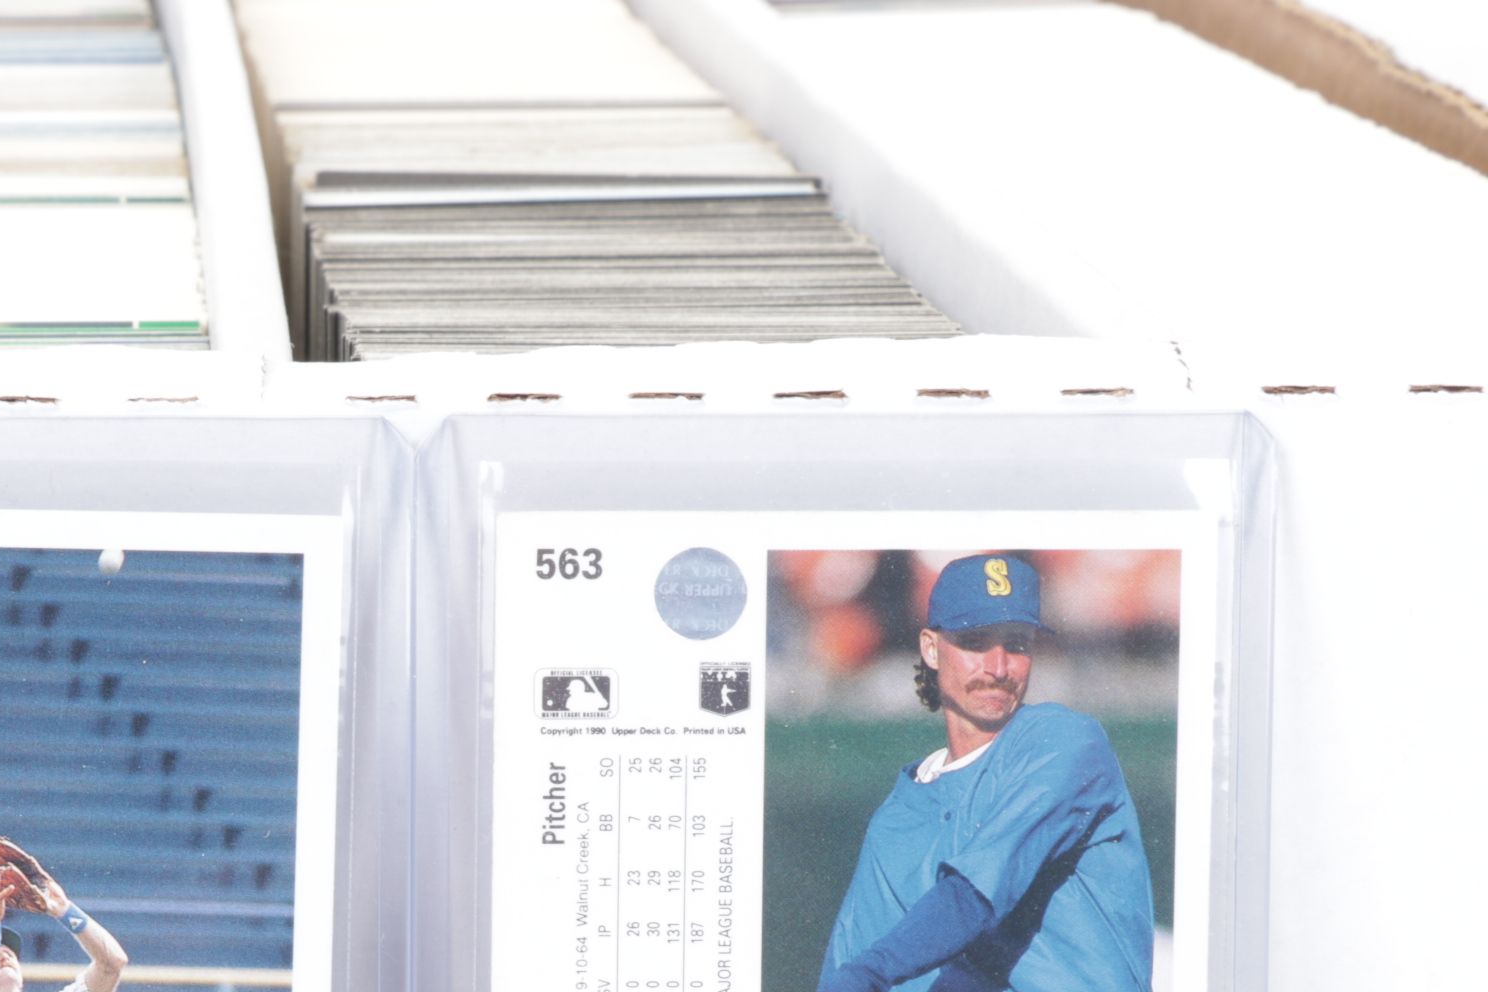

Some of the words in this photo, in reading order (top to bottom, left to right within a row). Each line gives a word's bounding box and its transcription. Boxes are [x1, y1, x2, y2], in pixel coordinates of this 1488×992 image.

[536, 548, 603, 580] 563
[984, 559, 1012, 596] S
[541, 727, 582, 736] Copyright
[586, 727, 606, 735] 1990
[612, 728, 637, 736] Upper
[640, 727, 660, 735] Deck
[684, 727, 714, 735] Printed
[542, 762, 567, 845] Pitcher
[578, 802, 590, 824] CA
[576, 879, 590, 926] Walnut
[719, 899, 733, 954] LEAGUE
